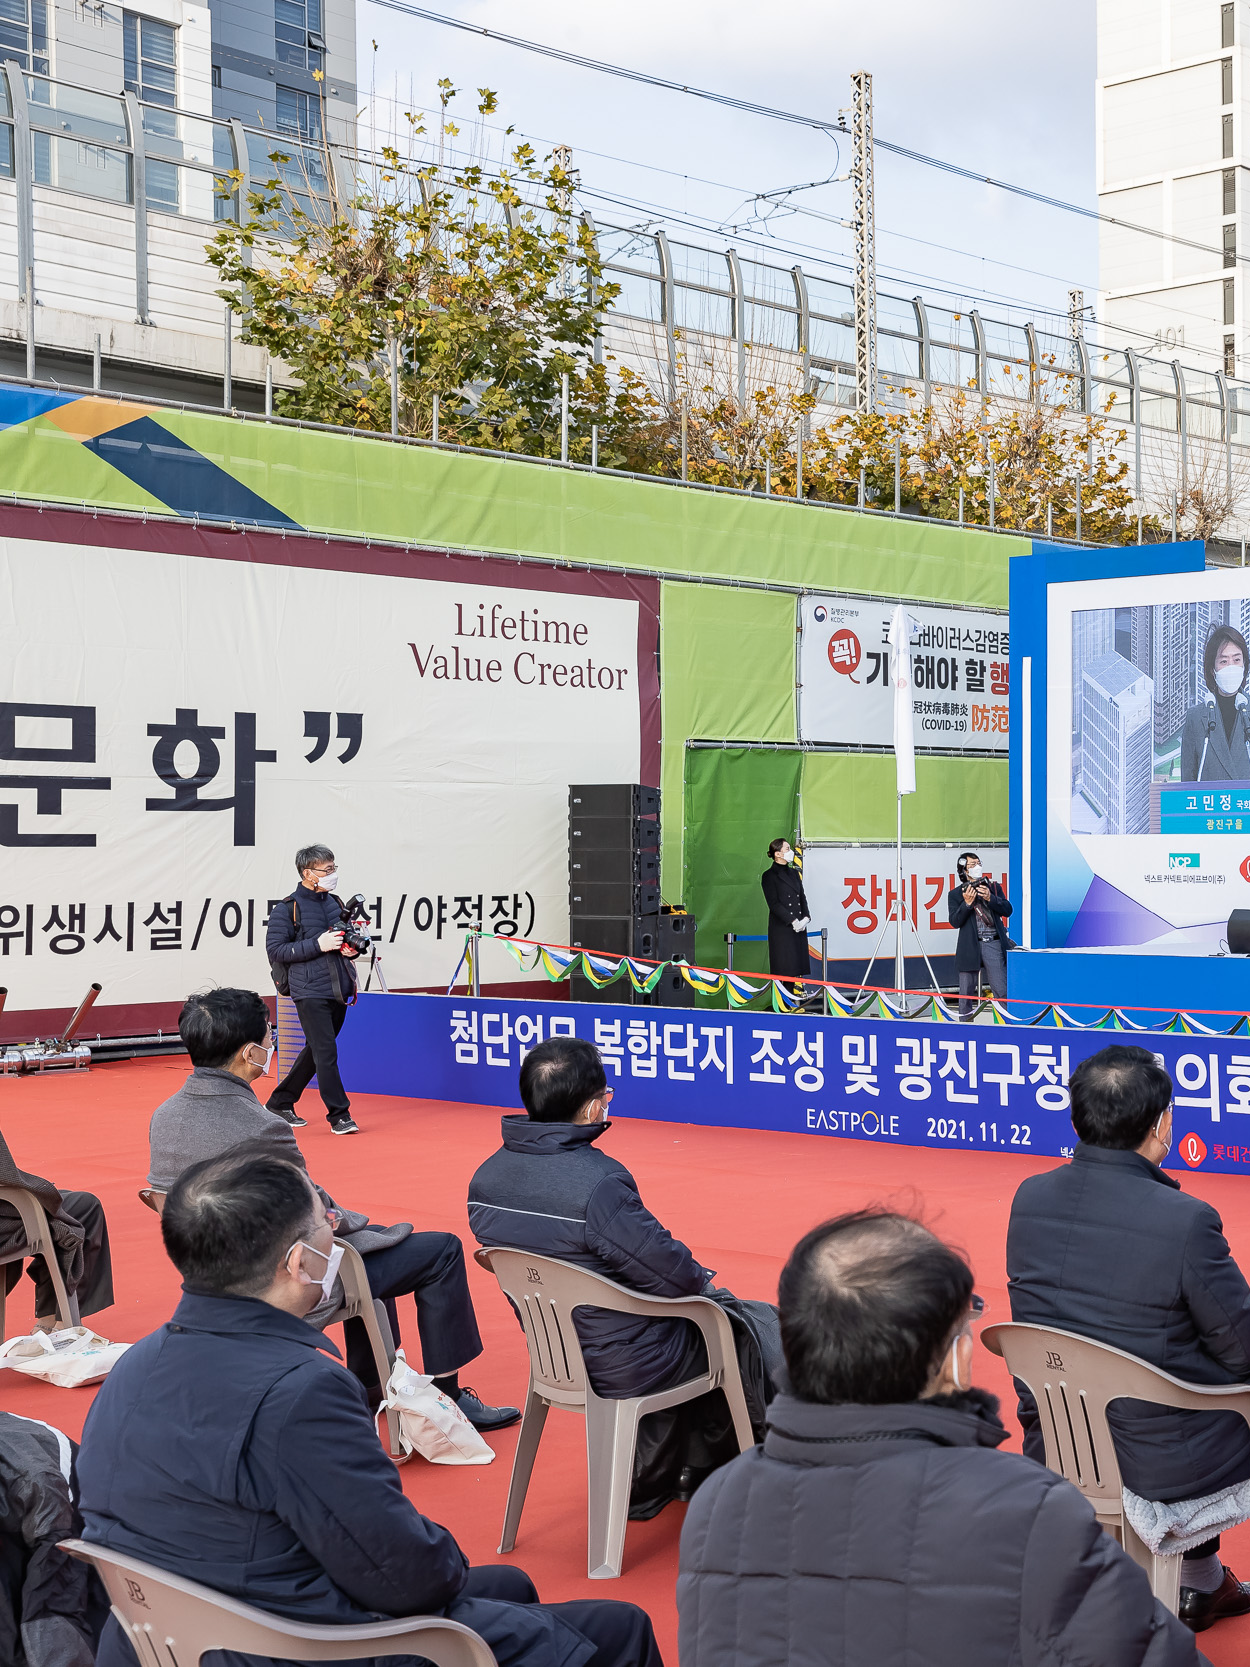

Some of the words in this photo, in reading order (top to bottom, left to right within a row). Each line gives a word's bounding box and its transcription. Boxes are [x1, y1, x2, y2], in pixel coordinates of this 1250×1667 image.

[454, 603, 589, 646] Lifetime
[882, 621, 1009, 655] 코바이러스감염증
[407, 642, 503, 684] Value
[512, 652, 628, 691] Creator
[866, 652, 958, 691] 기해야
[965, 658, 986, 693] 할
[922, 718, 967, 732] (COVID-19)
[1170, 856, 1191, 869] NCP
[594, 1018, 734, 1084] 복합단지
[749, 1029, 825, 1093] 조성
[842, 1034, 881, 1097] 및
[894, 1037, 1071, 1111] 광진구청
[807, 1108, 900, 1136] EASTPOLE
[927, 1117, 973, 1142] 2021.
[979, 1122, 1006, 1145] 11.
[1010, 1125, 1032, 1146] 22
[526, 1266, 540, 1281] JB
[1046, 1350, 1063, 1367] JB
